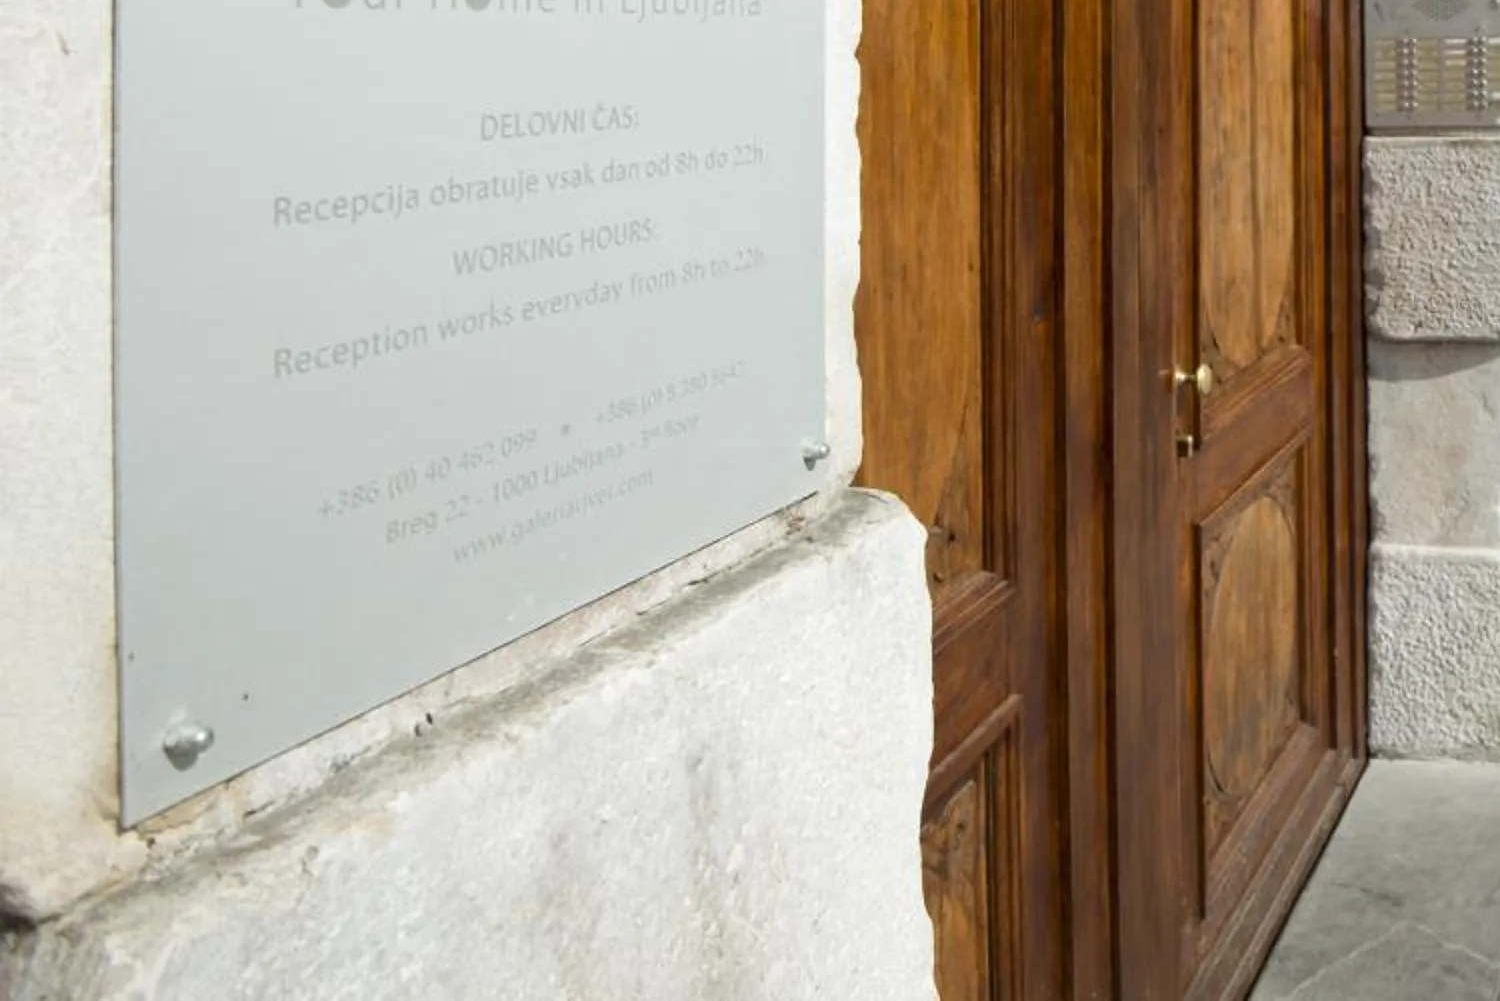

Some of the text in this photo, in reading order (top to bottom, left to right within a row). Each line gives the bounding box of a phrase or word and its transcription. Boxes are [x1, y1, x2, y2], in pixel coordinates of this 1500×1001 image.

[480, 107, 586, 142] DELOVNI
[273, 183, 420, 228] Recepcija
[429, 170, 539, 207] obratuje
[546, 161, 596, 191] vsak
[602, 157, 640, 184] dan
[645, 152, 671, 178] od
[675, 150, 698, 175] 8h
[704, 148, 729, 171] do
[452, 232, 573, 276] WORKING
[273, 324, 429, 379] Reception
[437, 299, 516, 341] works
[521, 280, 623, 321] everyday
[629, 267, 677, 297] from
[710, 258, 731, 279] to
[387, 465, 418, 500] (0)
[424, 456, 451, 482] 40
